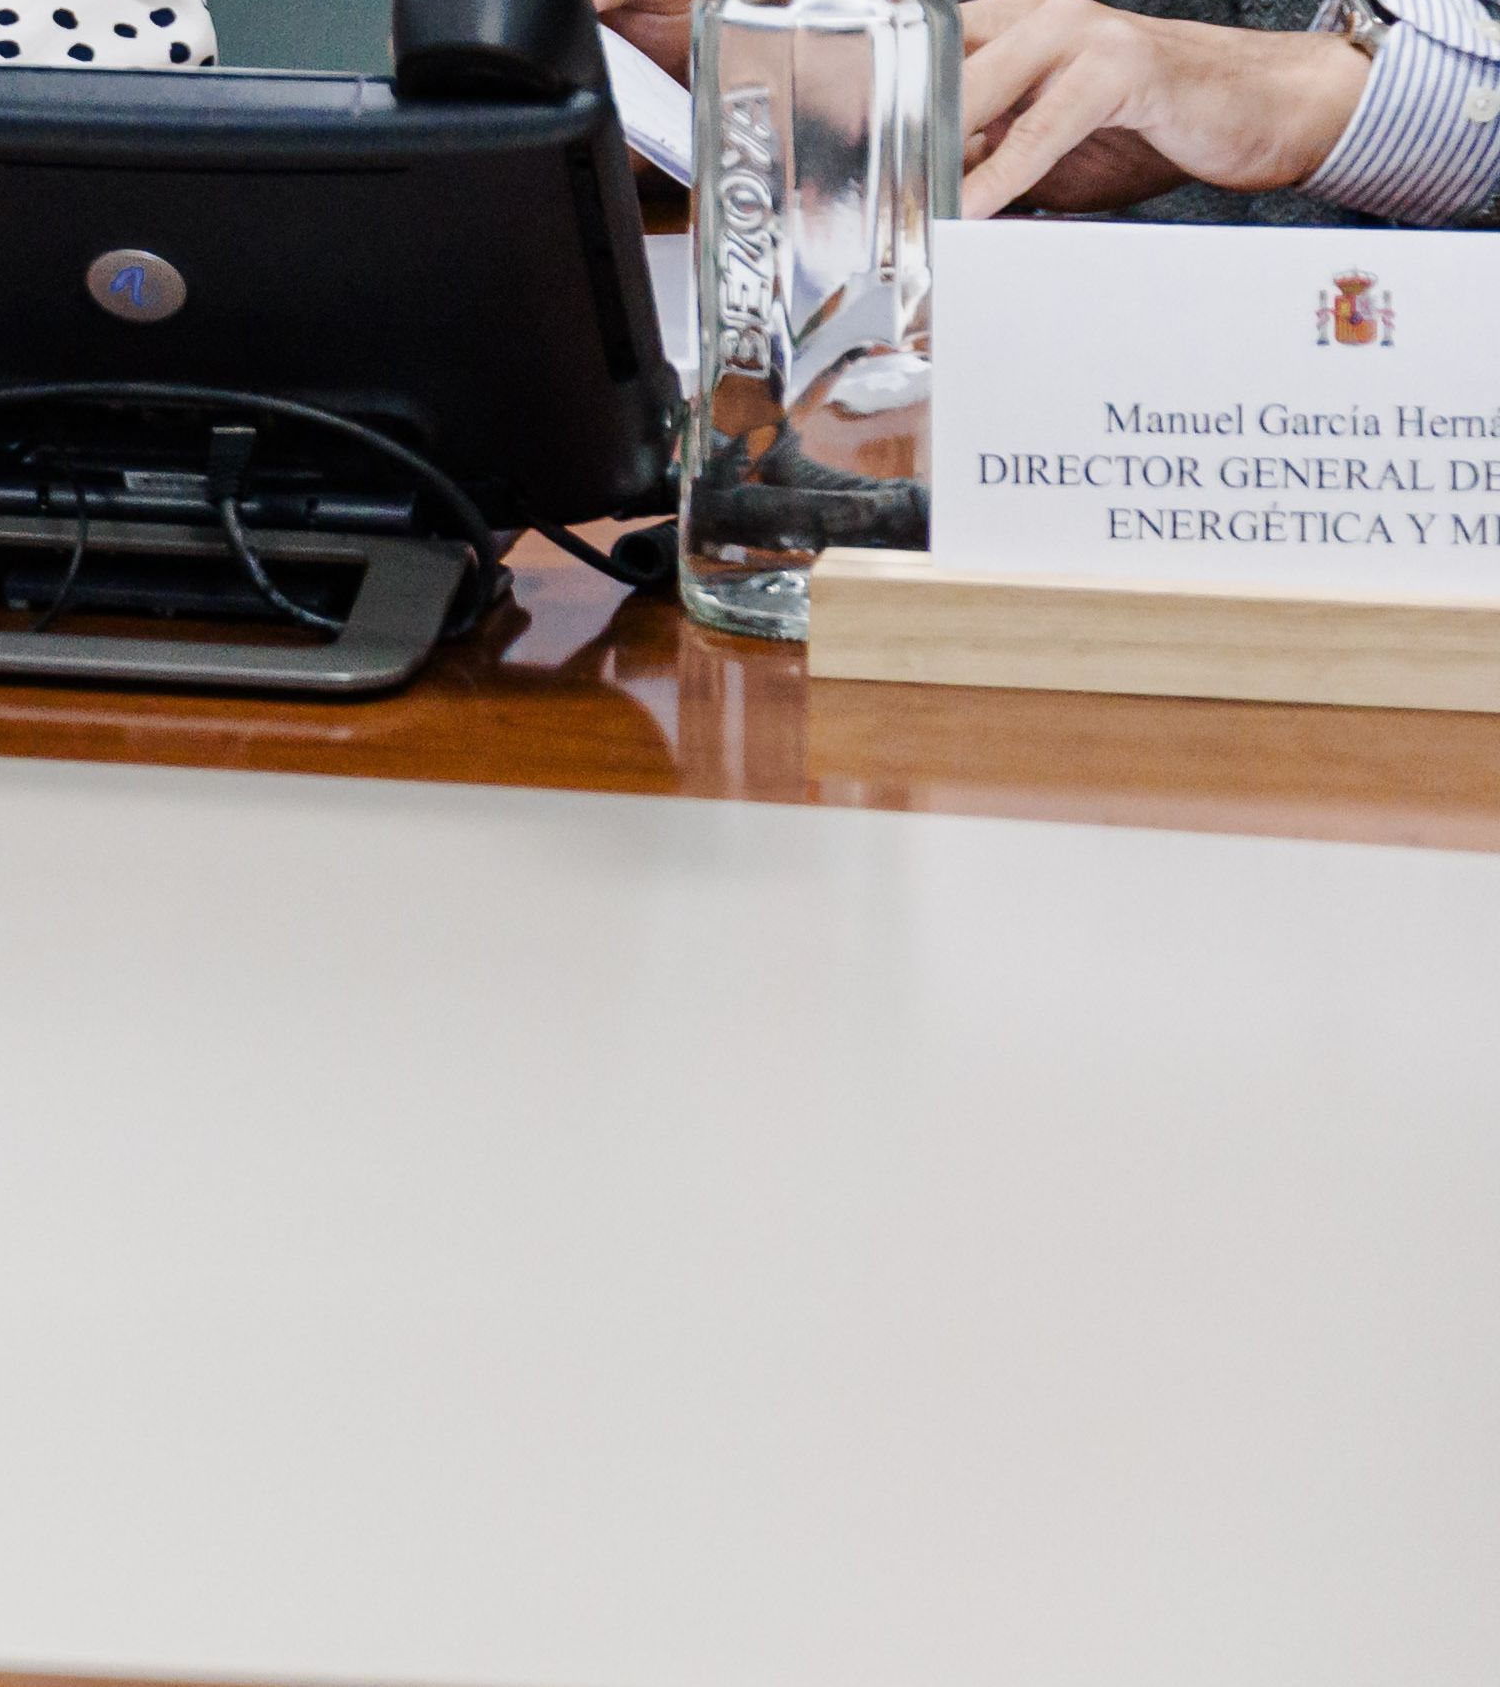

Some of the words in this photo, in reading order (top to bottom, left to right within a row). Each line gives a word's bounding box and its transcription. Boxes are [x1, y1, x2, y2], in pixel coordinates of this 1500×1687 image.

[1103, 400, 1245, 438] Manuel
[1255, 402, 1383, 439] García
[977, 452, 1205, 490] DIRECTOR
[1214, 455, 1436, 494] GENERAL
[1106, 500, 1397, 546] ENERGÉTICA
[1405, 512, 1439, 546] Y
